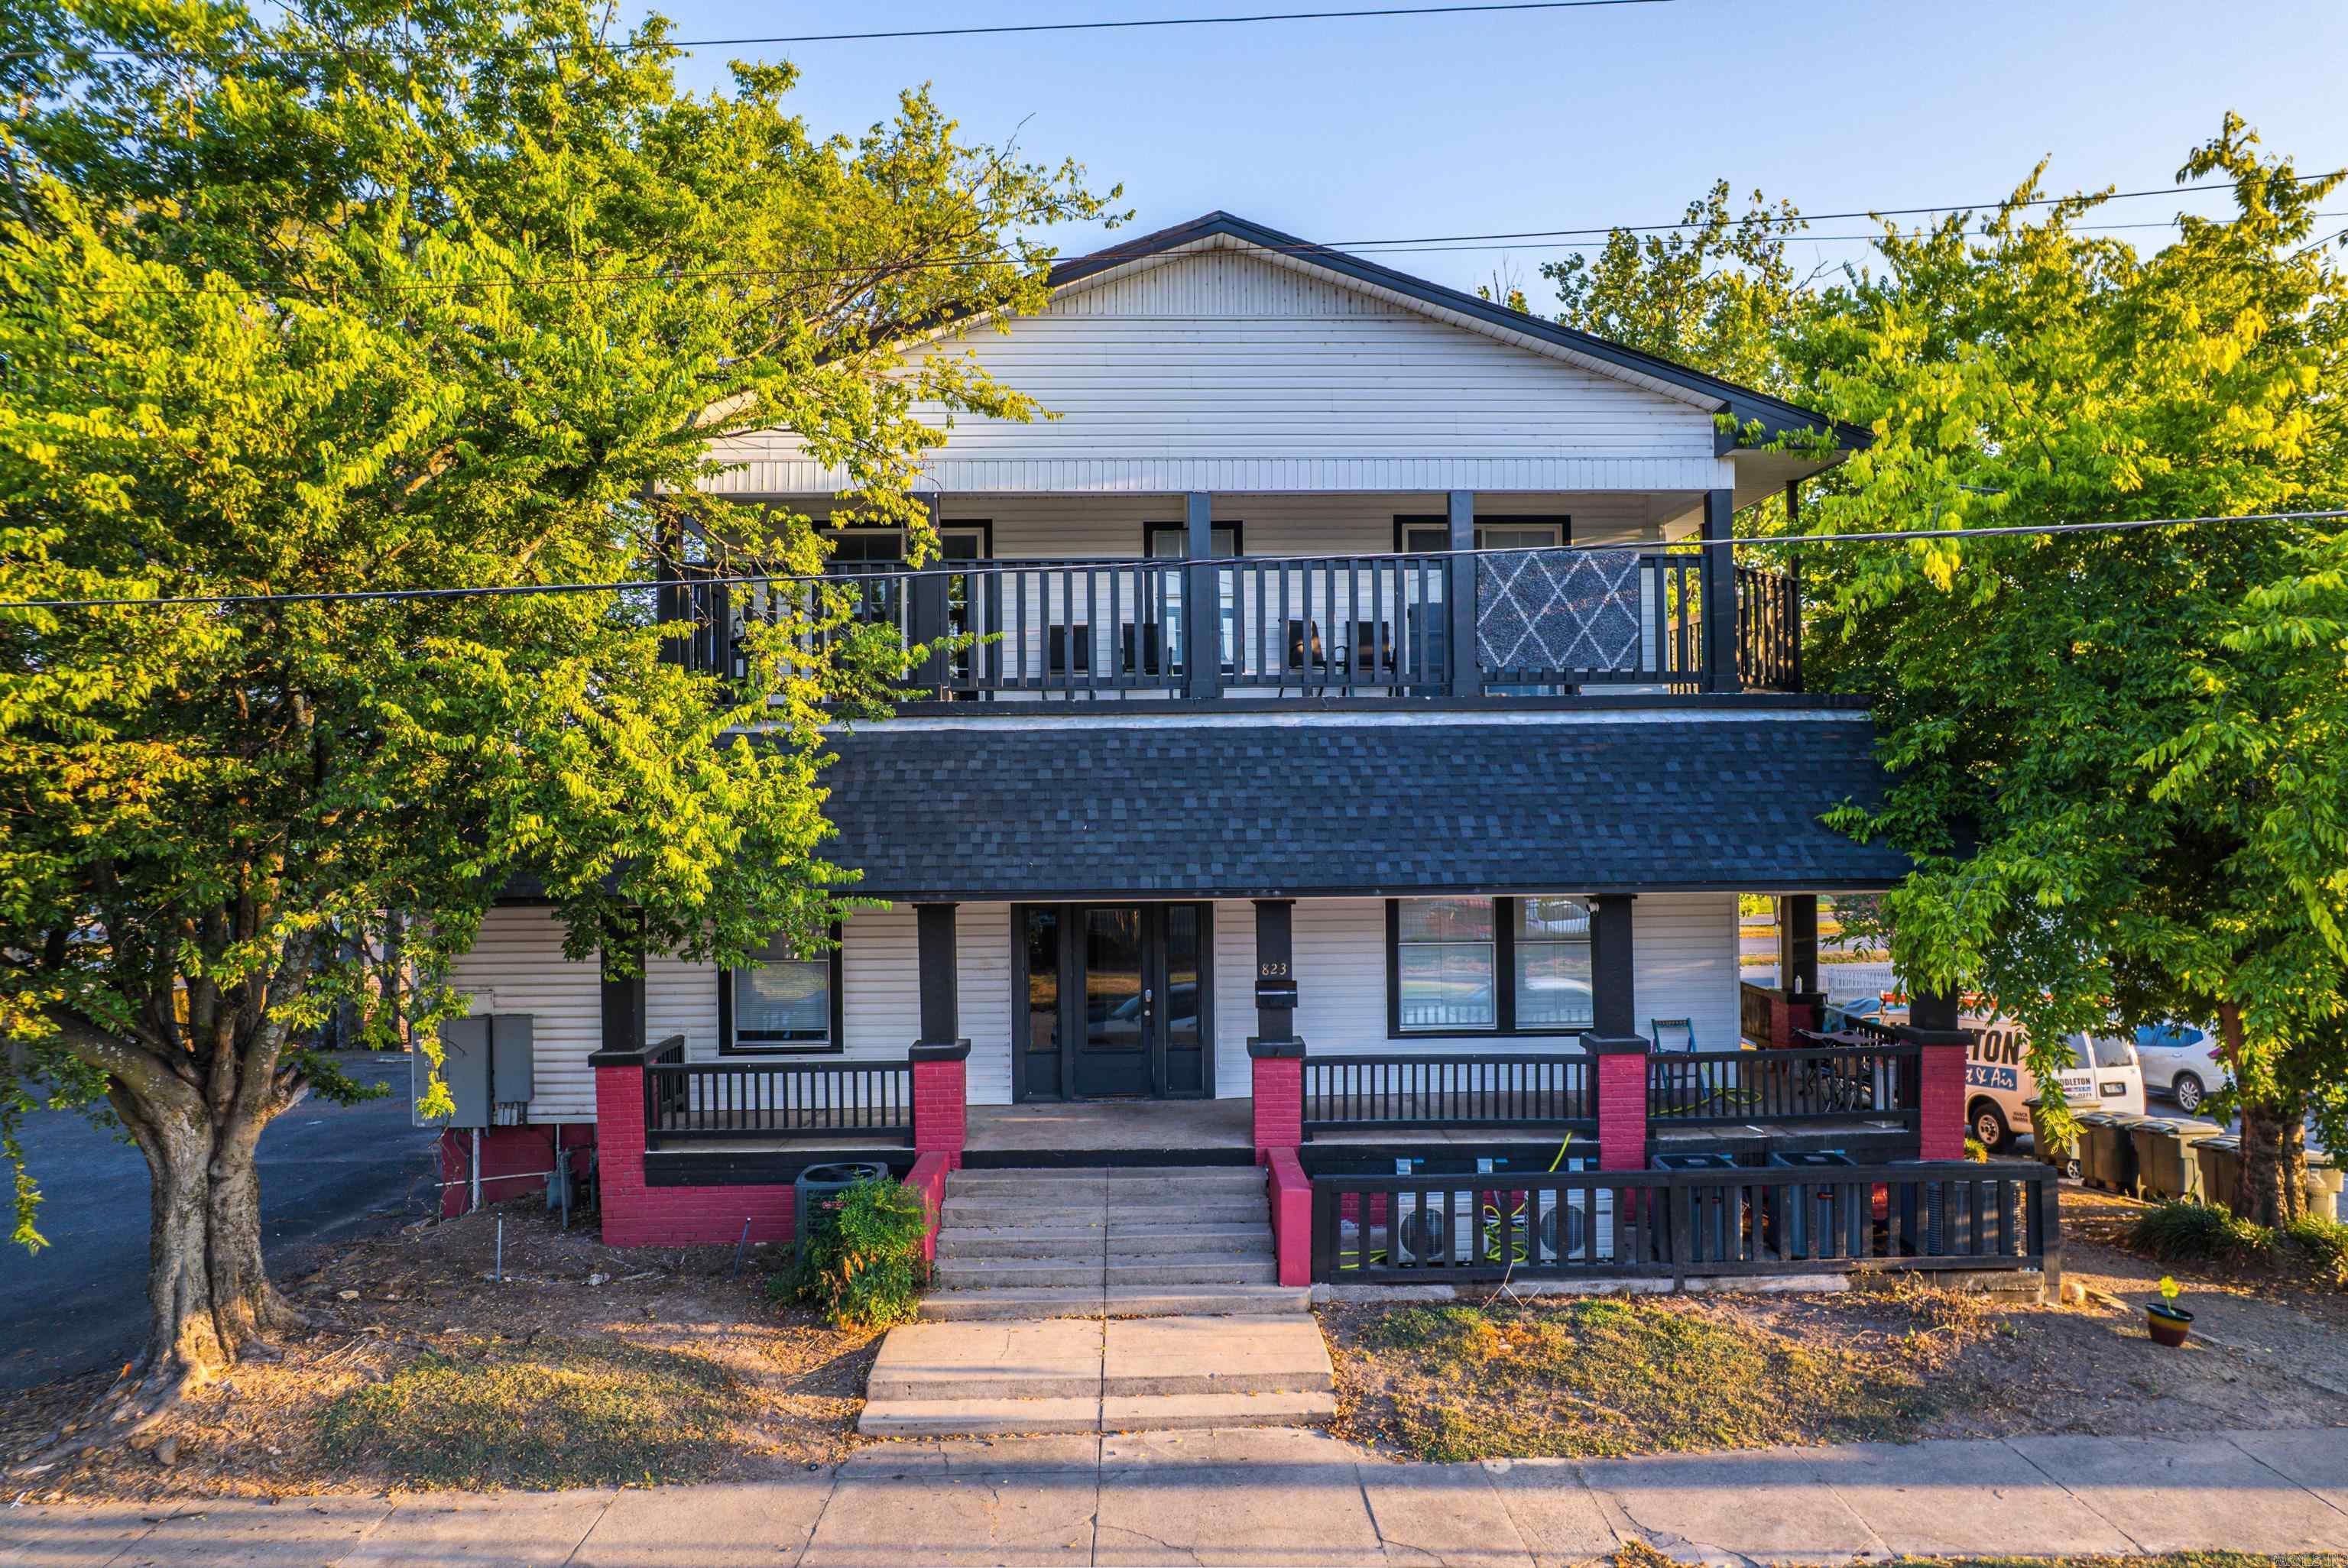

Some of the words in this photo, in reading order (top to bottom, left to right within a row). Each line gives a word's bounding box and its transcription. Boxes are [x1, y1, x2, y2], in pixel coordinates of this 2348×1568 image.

[1262, 963, 1287, 976] 823
[1964, 1028, 2022, 1065] TON
[1976, 1067, 1987, 1084] &
[1990, 1067, 2014, 1087] Air
